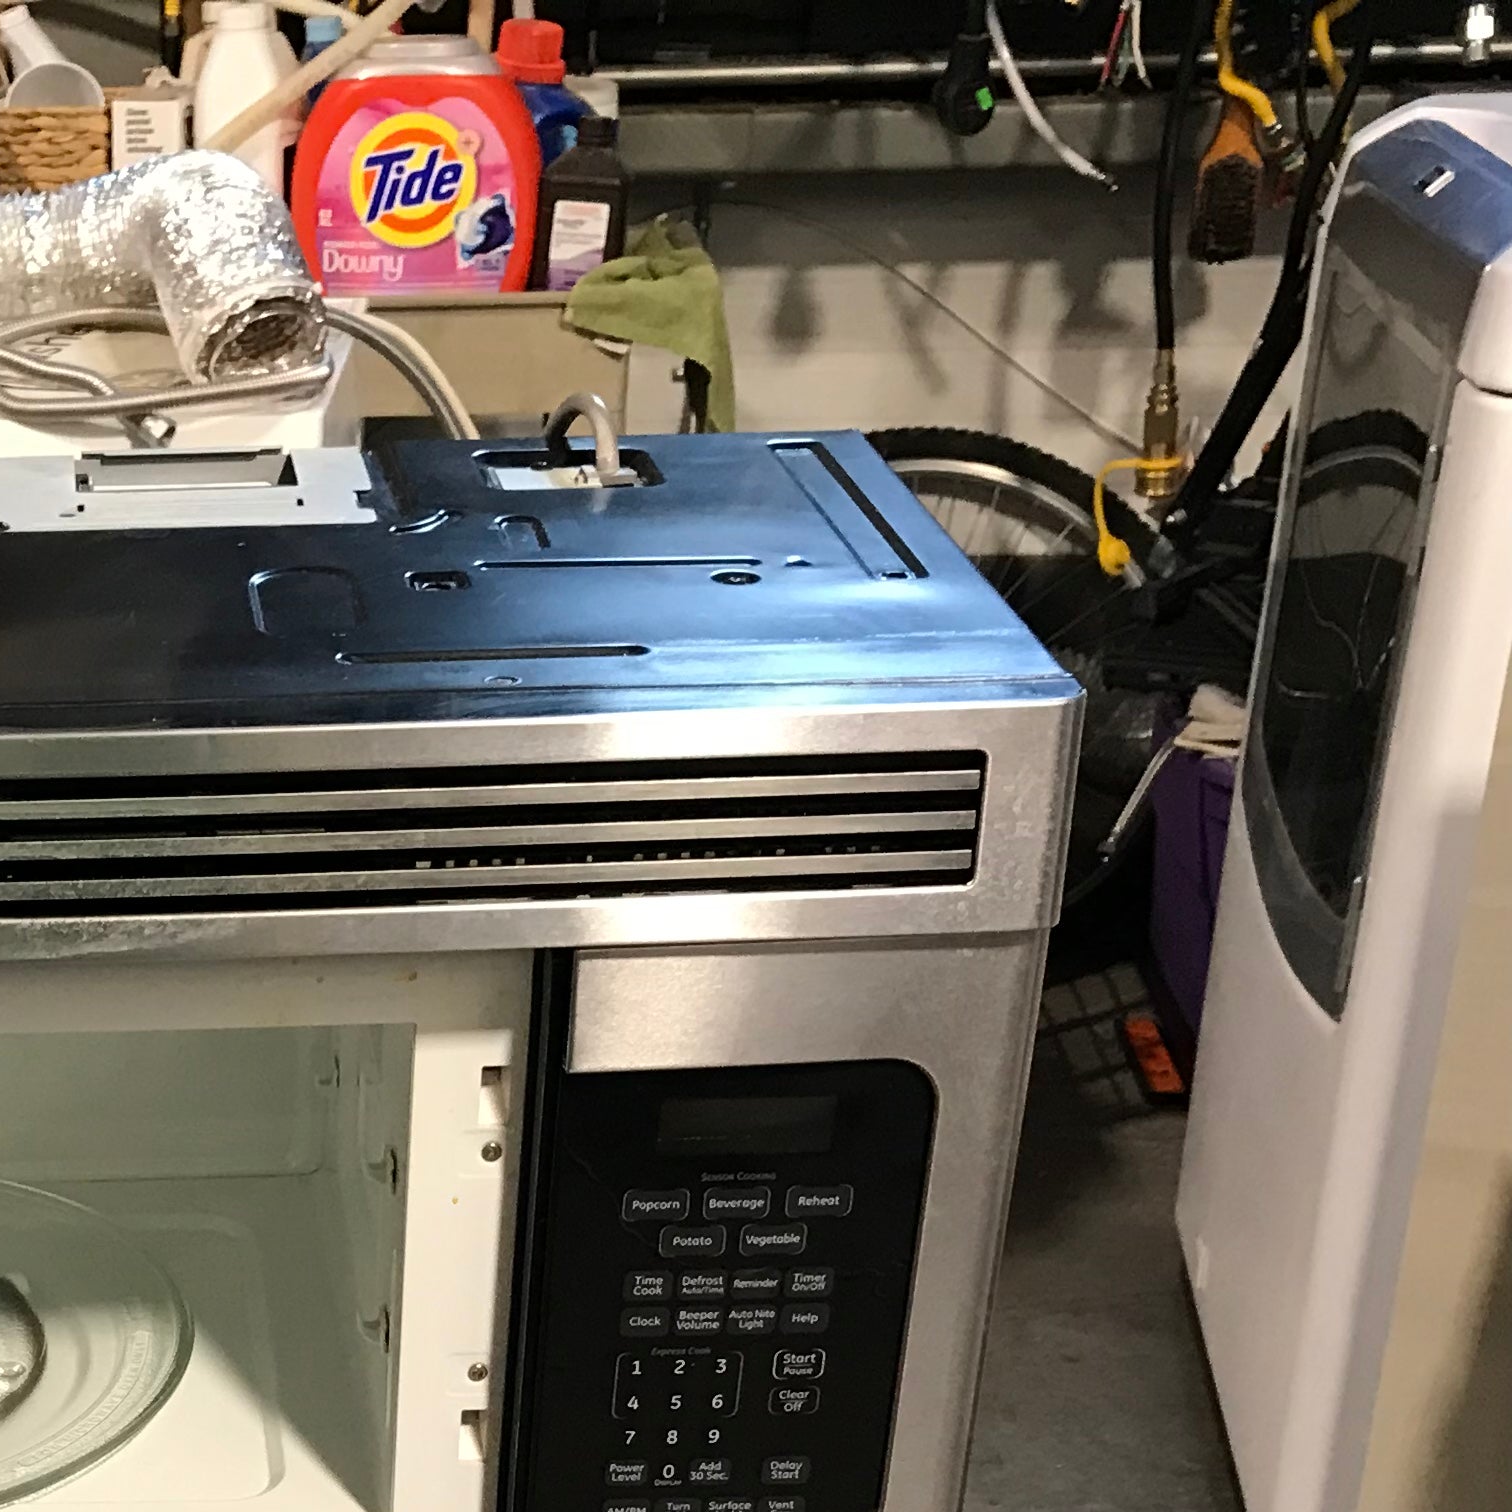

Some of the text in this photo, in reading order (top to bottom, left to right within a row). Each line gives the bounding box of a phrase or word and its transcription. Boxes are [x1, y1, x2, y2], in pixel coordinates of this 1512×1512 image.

[363, 147, 464, 223] Tide
[322, 249, 406, 281] Downy
[632, 1199, 681, 1213] Popcorn
[708, 1197, 766, 1211] Beverage
[797, 1195, 840, 1207] Reheat
[672, 1235, 713, 1247] Potato
[745, 1233, 801, 1248] Vegetable
[634, 1275, 664, 1286] Time
[681, 1275, 724, 1287] Defrost
[732, 1277, 779, 1290] Reminder
[792, 1272, 827, 1283] Timer
[632, 1285, 663, 1296] Cook
[791, 1282, 827, 1292] On/Off
[678, 1309, 720, 1321] Beeper
[728, 1309, 776, 1320] Auto Nite
[791, 1312, 819, 1325] Help
[629, 1316, 661, 1327] Clock
[676, 1319, 721, 1330] Volume
[738, 1318, 764, 1331] Light
[782, 1352, 816, 1365] Start
[631, 1360, 642, 1375] 1
[673, 1359, 686, 1375] 2
[715, 1358, 727, 1374] 3
[782, 1366, 813, 1376] Pause
[778, 1389, 810, 1400] Clear
[627, 1395, 639, 1410] 4
[670, 1394, 682, 1410] 5
[711, 1393, 724, 1409] 6
[783, 1401, 804, 1413] Off
[625, 1430, 636, 1445] 7
[666, 1429, 678, 1445] 8
[708, 1429, 720, 1444] 9
[609, 1463, 644, 1473] Power
[662, 1463, 675, 1479] 0
[698, 1461, 722, 1471] Add
[770, 1460, 803, 1471] Delay
[611, 1472, 642, 1482] Level
[690, 1470, 729, 1482] 30 Sec.
[770, 1470, 800, 1480] Start
[666, 1502, 691, 1511] Turn
[708, 1500, 752, 1511] Surface
[768, 1500, 795, 1510] Vent
